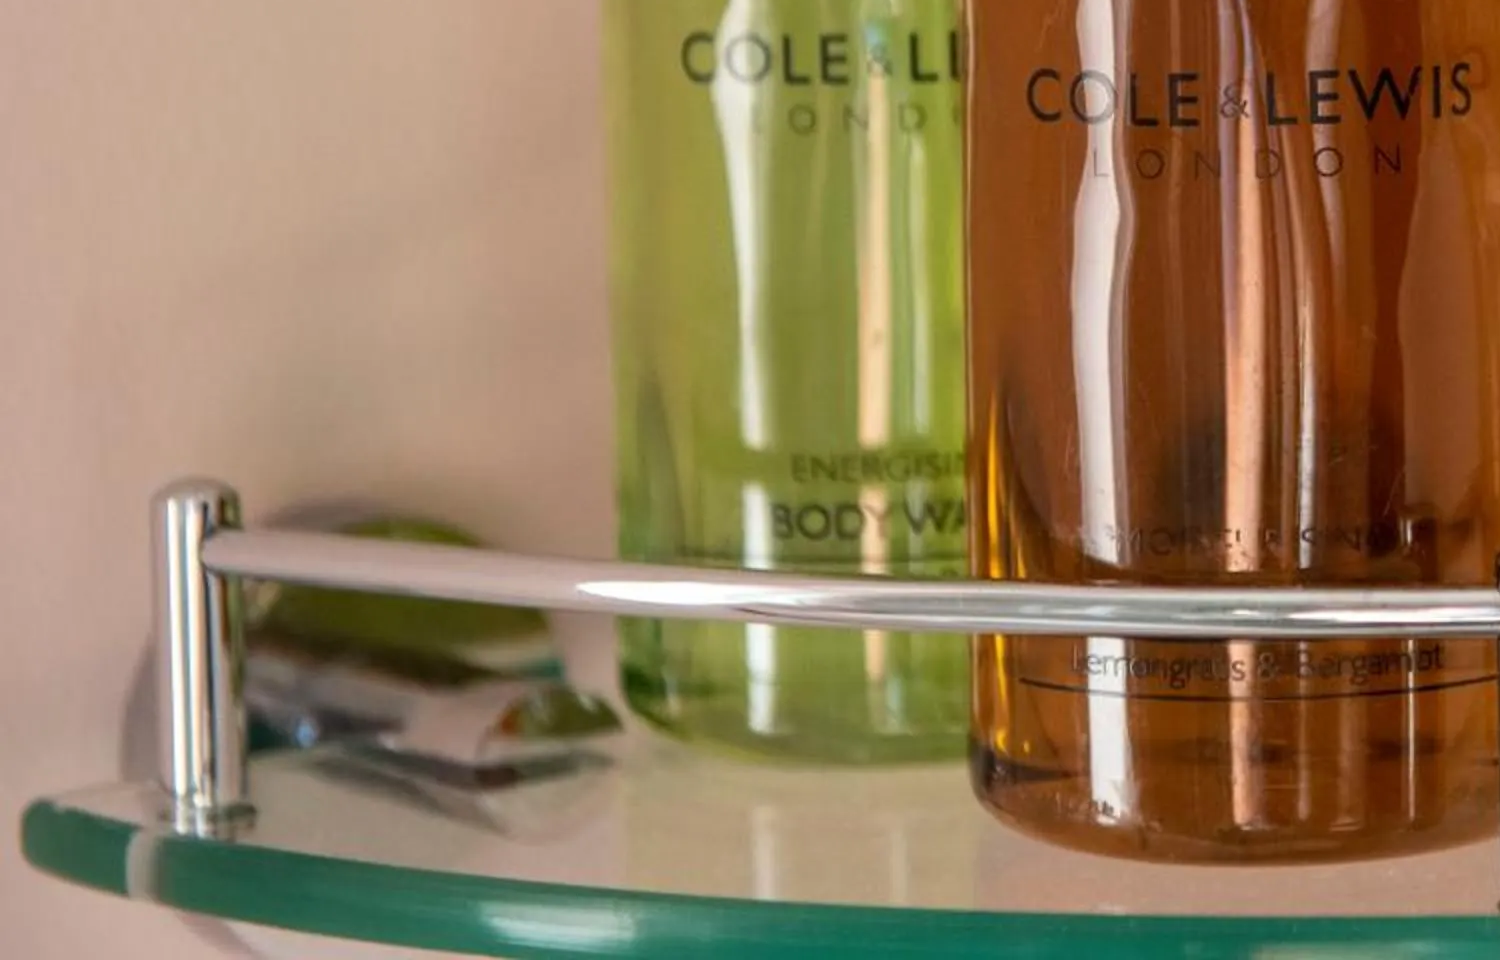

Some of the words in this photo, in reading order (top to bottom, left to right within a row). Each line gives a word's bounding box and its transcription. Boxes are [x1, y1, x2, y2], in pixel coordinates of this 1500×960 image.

[681, 29, 849, 84] COLE
[1026, 68, 1199, 128] COLE
[1219, 83, 1250, 120] &
[1264, 62, 1472, 127] LEWIS
[752, 102, 962, 136] OND
[1093, 144, 1402, 180] LONDON
[771, 502, 895, 540] BODY
[1258, 653, 1284, 682] &
